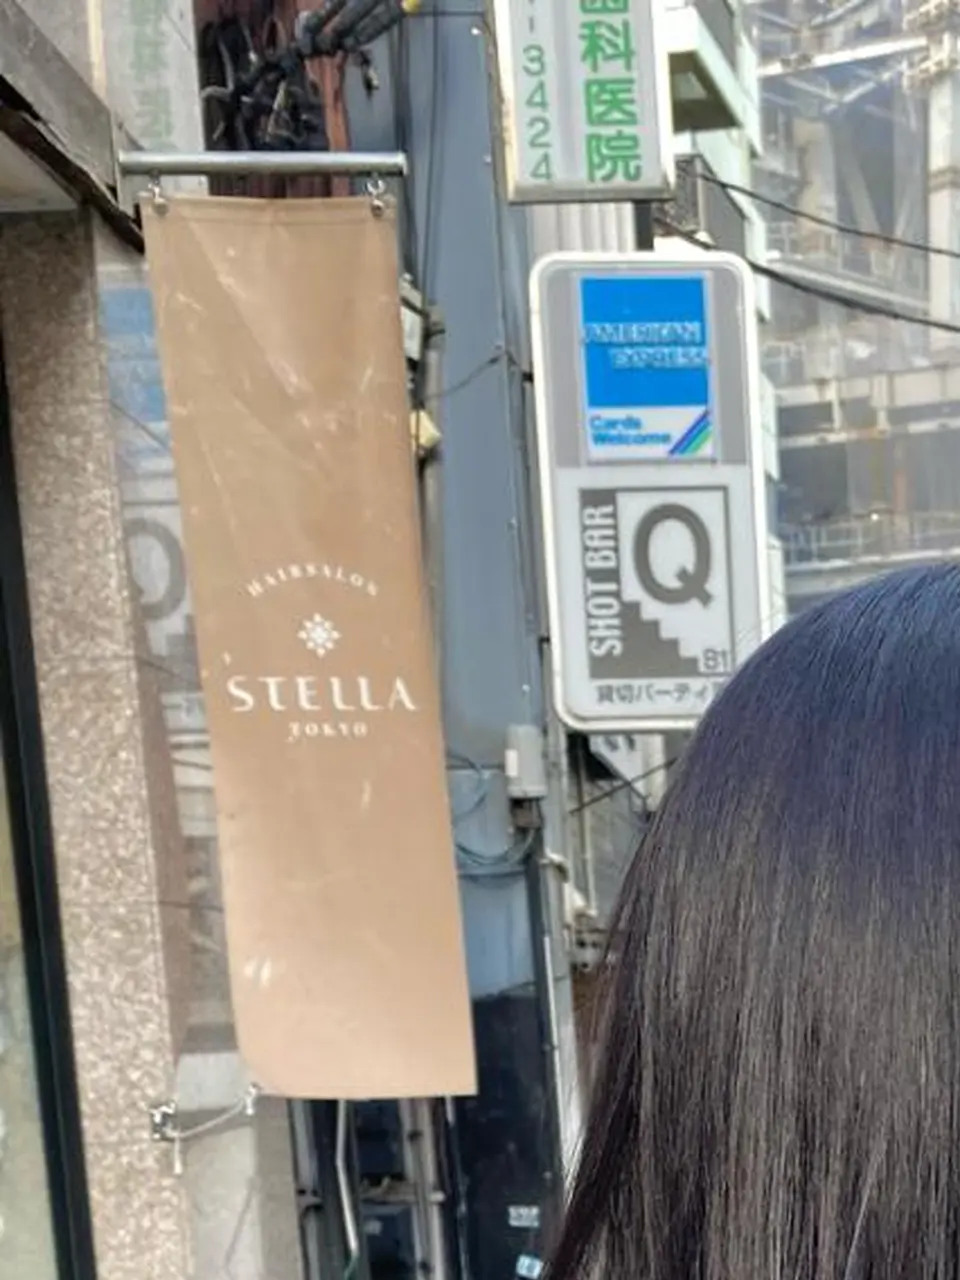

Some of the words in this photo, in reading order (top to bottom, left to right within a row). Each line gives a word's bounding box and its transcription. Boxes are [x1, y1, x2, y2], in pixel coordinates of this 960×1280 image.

[579, 0, 642, 182] 科医院
[583, 504, 617, 569] BAR
[633, 502, 714, 607] Q
[587, 577, 623, 656] SHOT
[226, 674, 419, 712] STELLA
